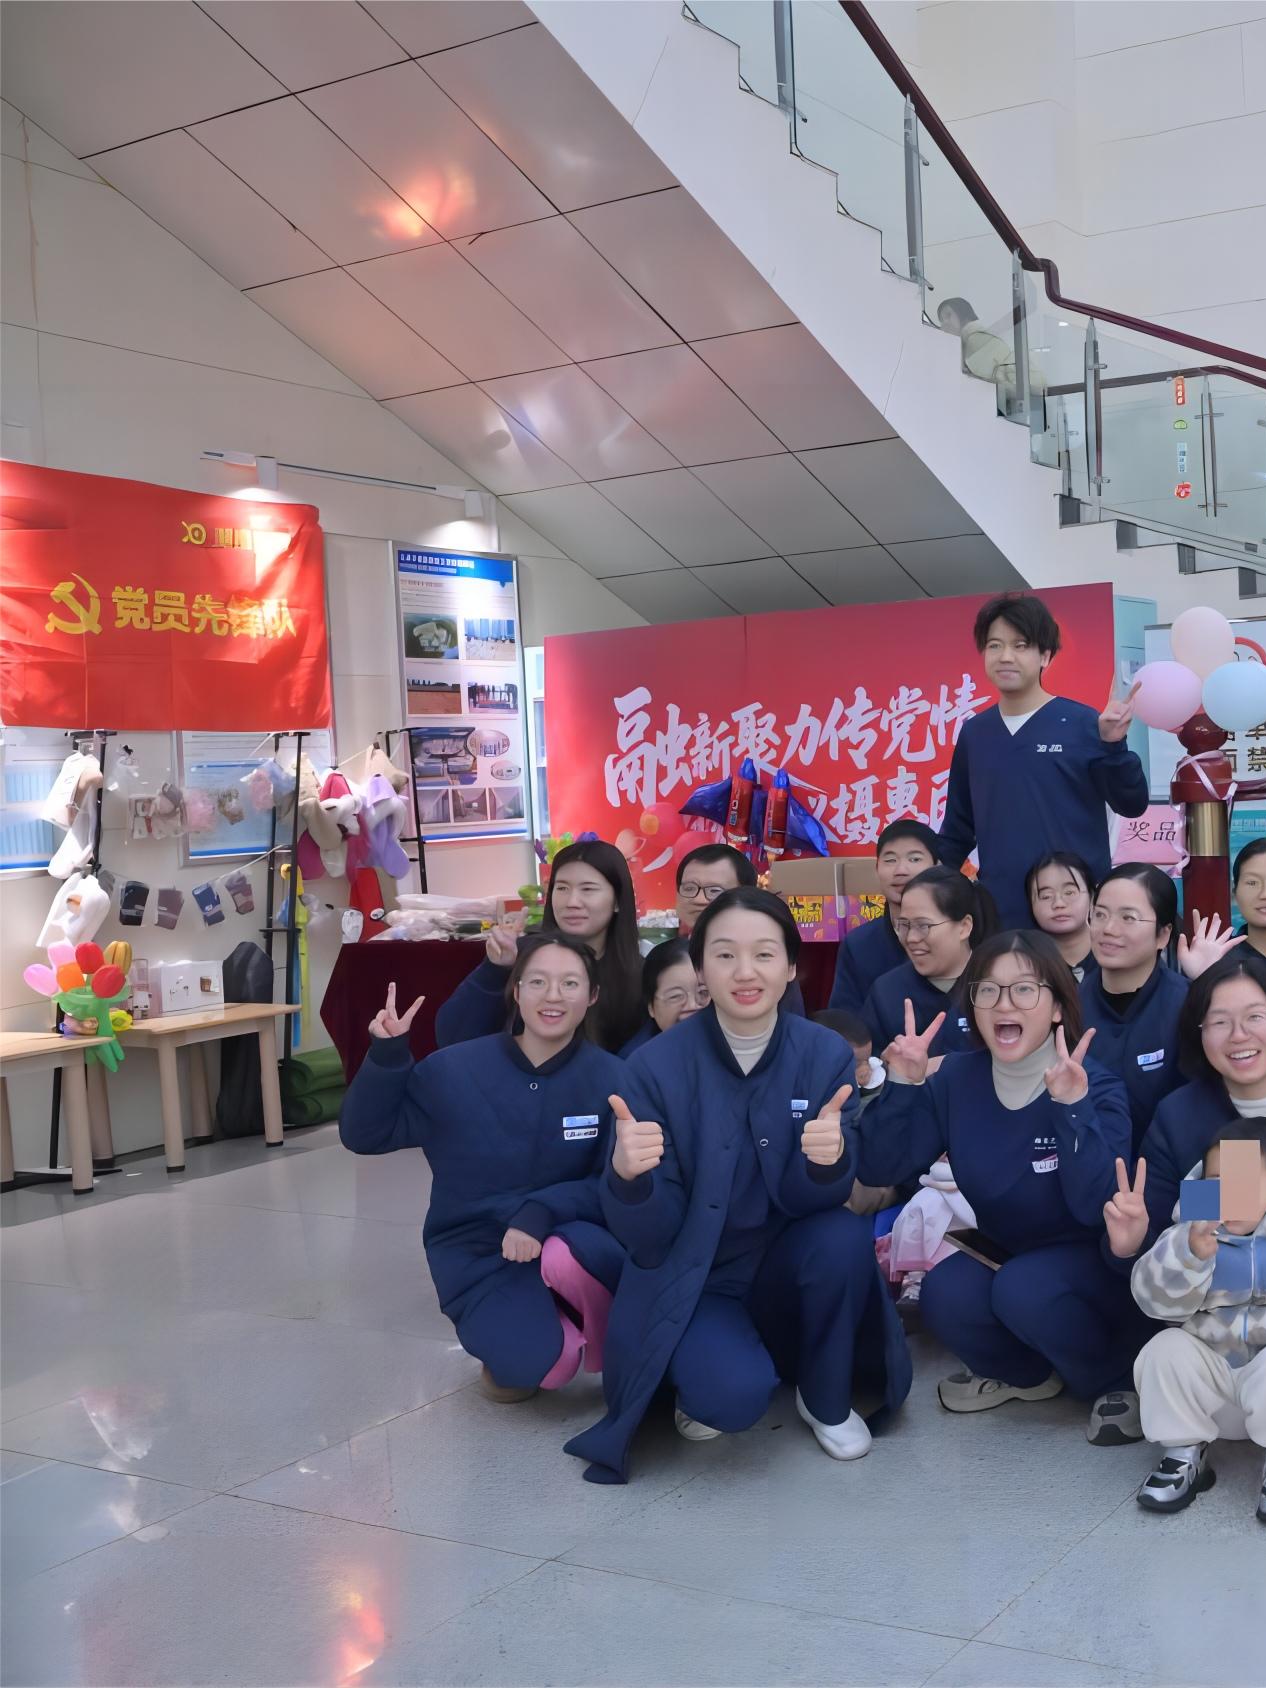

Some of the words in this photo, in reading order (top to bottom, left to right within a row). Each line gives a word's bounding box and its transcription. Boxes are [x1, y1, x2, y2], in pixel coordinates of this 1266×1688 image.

[112, 586, 297, 639] 党员先锋队
[1121, 821, 1176, 843] 奖品
